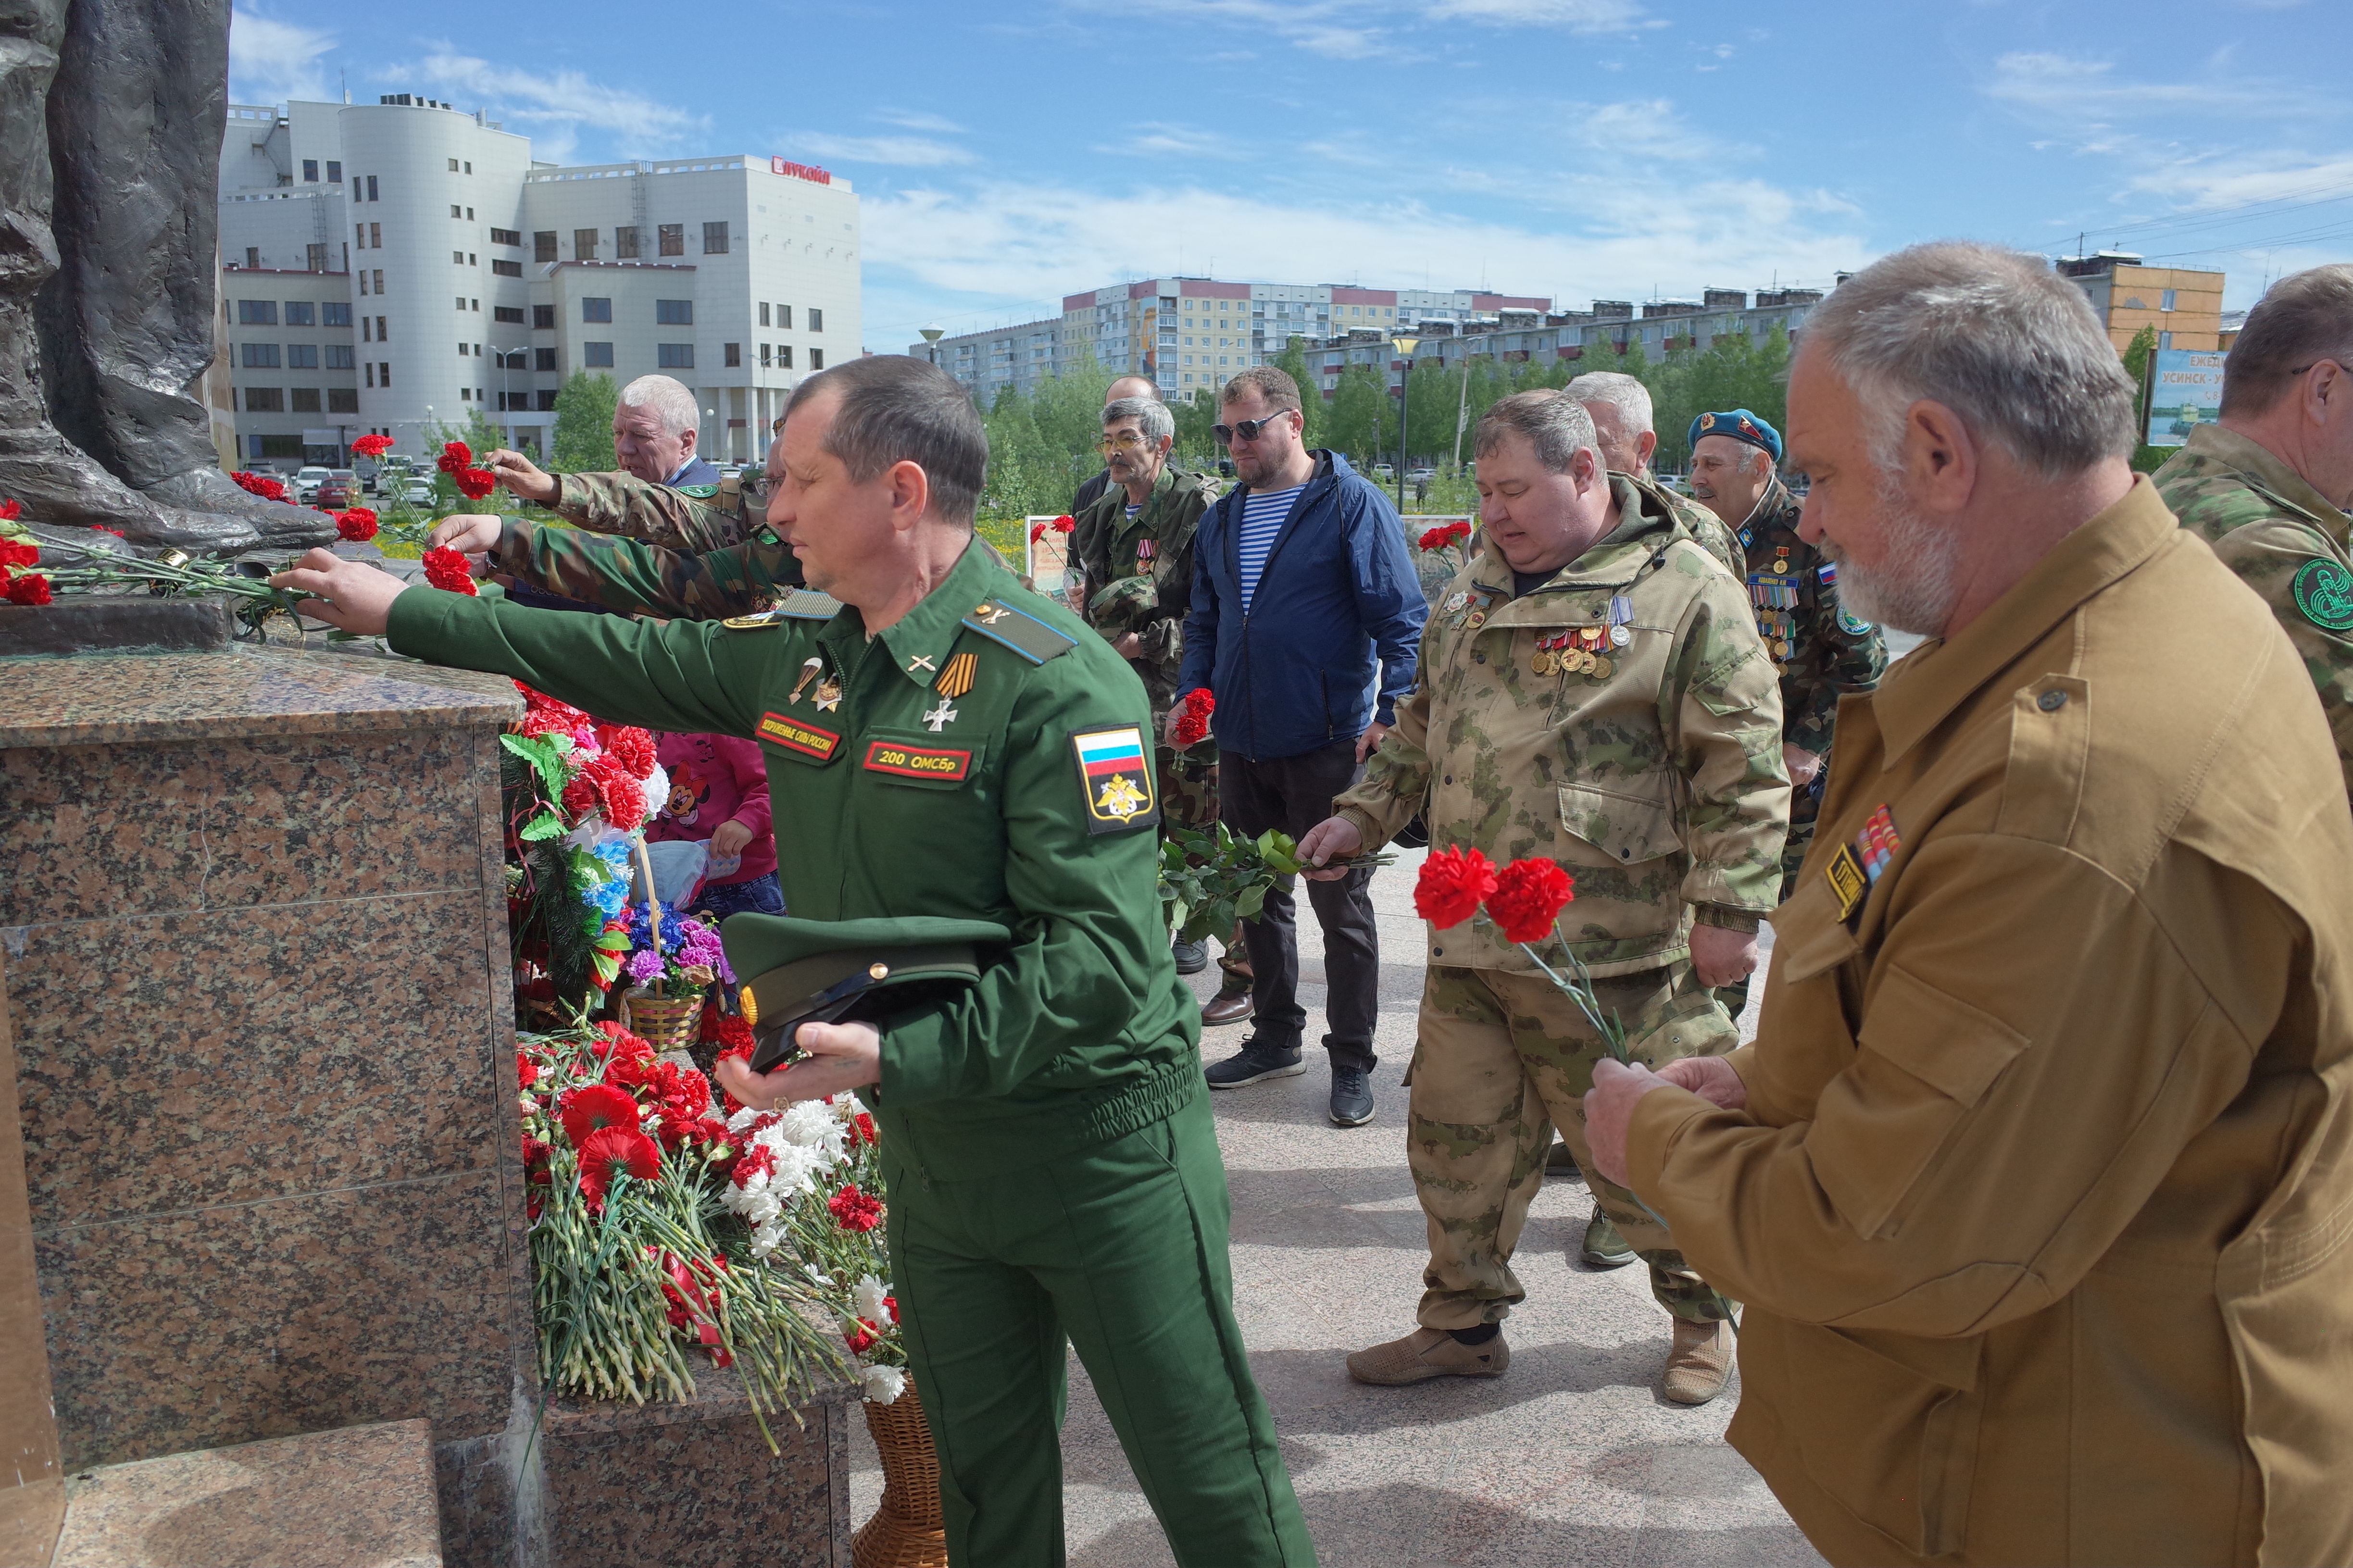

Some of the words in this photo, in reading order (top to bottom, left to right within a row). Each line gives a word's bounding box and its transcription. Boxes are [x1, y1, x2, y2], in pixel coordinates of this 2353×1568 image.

[784, 160, 831, 185] ЛУКОЙЛ
[2163, 373, 2206, 384] УСИНСК
[1851, 622, 1870, 633] РОССИЯ
[762, 719, 797, 739] ВООРУЖЕННЫЕ
[795, 730, 811, 744] СИЛЫ
[807, 734, 832, 751] РОССИИ
[878, 750, 905, 765] 200
[911, 756, 956, 772] ОМСБр
